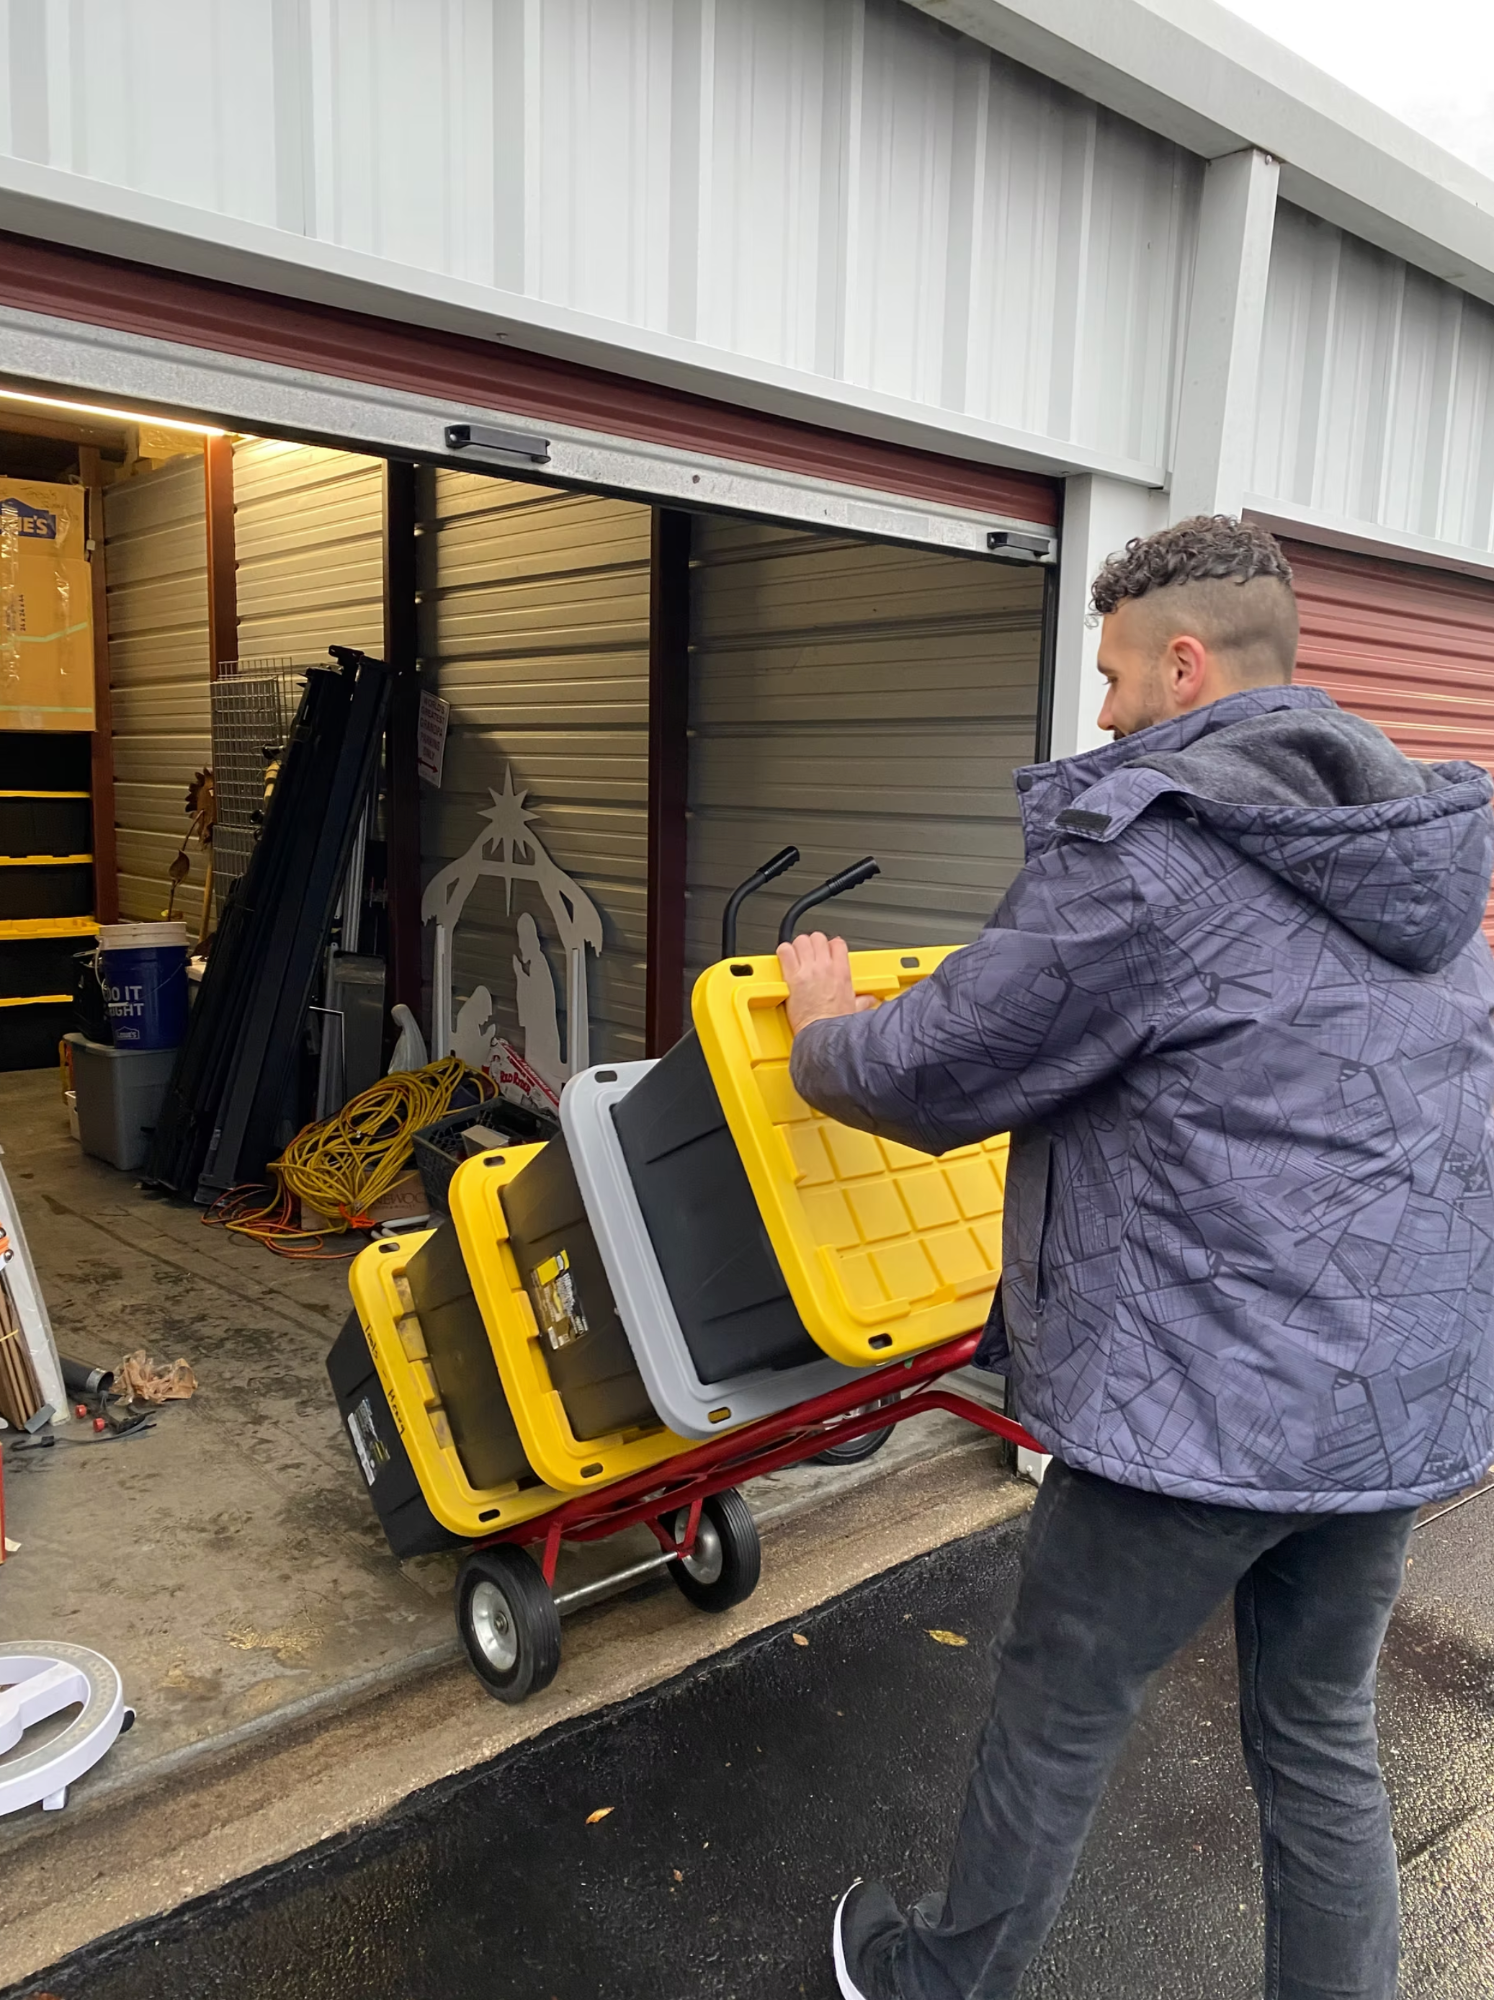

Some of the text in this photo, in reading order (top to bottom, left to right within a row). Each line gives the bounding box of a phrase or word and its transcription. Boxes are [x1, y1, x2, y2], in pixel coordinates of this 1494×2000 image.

[423, 696, 445, 714] WORLD'S
[420, 706, 445, 724] GREATEST
[420, 717, 443, 737] GRANDPA
[420, 732, 440, 751] PARKING
[423, 746, 435, 761] ONLY
[125, 985, 143, 1001] IT
[364, 1323, 379, 1360] Tools
[387, 1388, 406, 1436] Heavy
